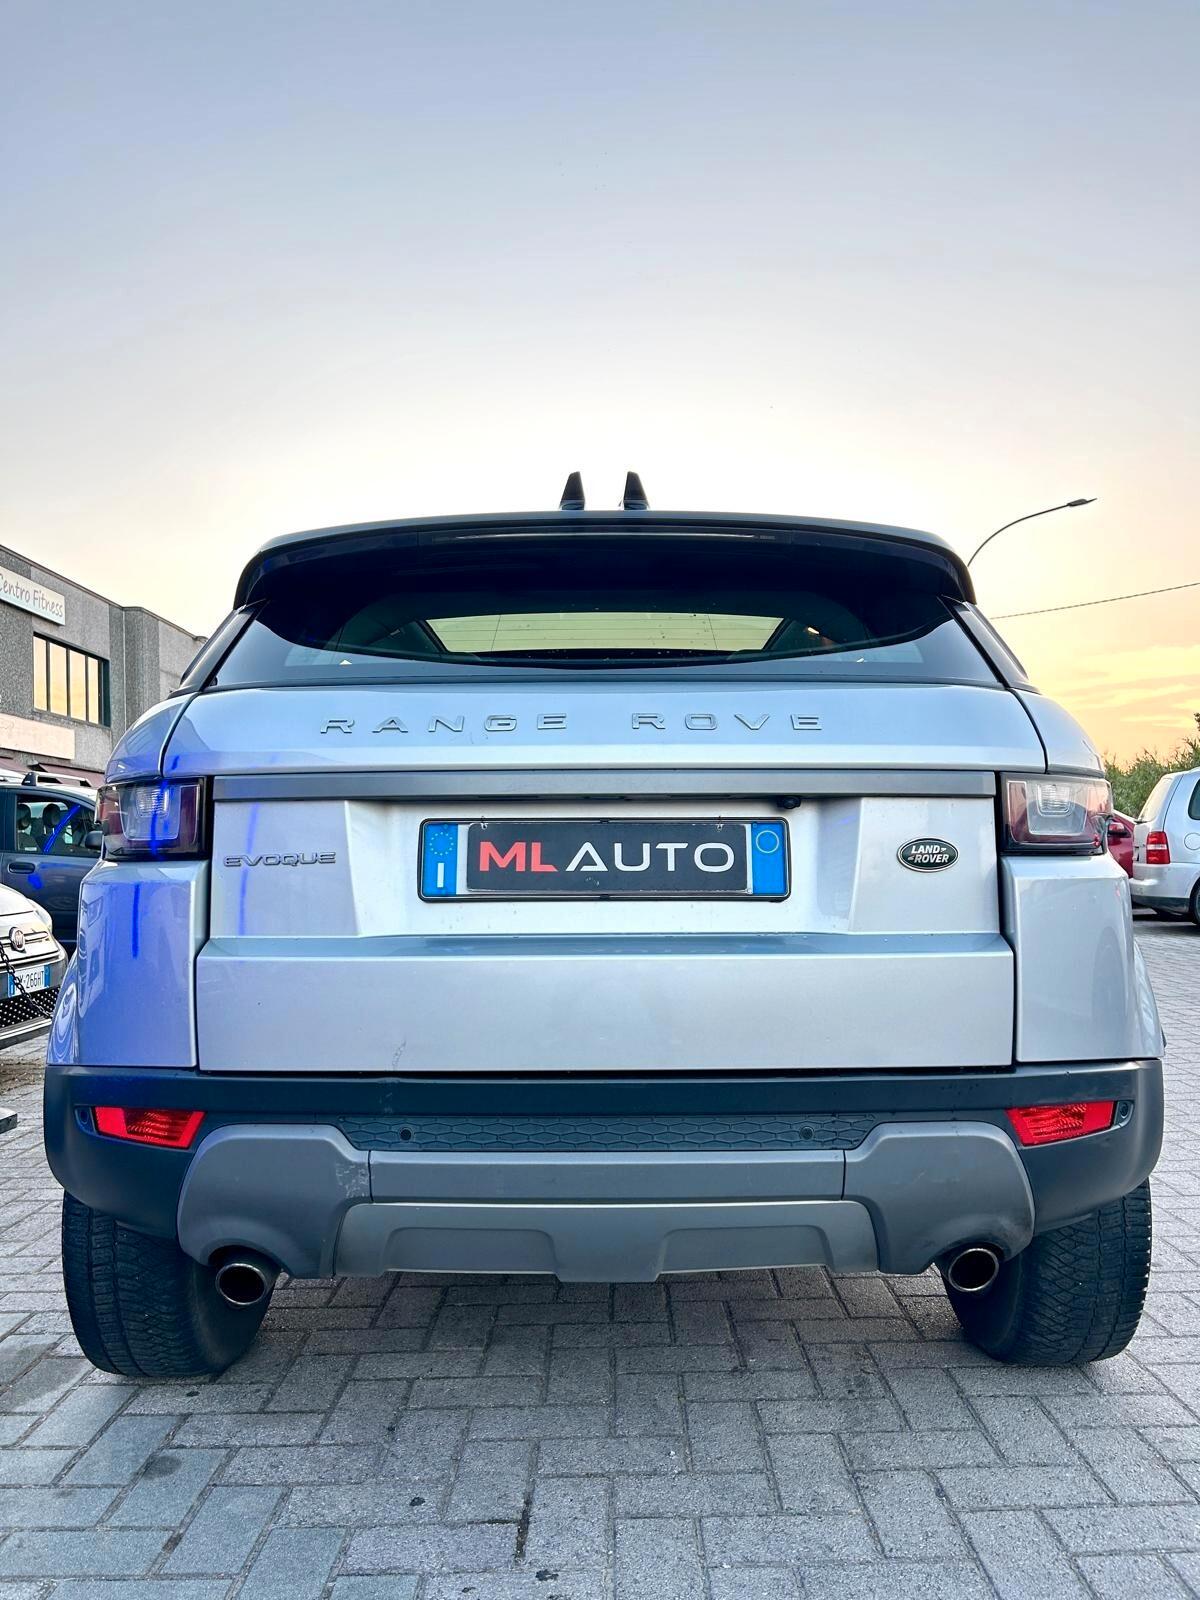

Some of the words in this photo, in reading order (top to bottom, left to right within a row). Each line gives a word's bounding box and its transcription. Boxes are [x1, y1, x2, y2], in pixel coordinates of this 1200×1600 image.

[33, 589, 63, 617] Fitness
[320, 713, 567, 734] RANGE
[632, 712, 822, 731] ROVE
[911, 845, 940, 854] LAND
[223, 852, 336, 867] EVOQUE
[914, 854, 949, 863] ROVER
